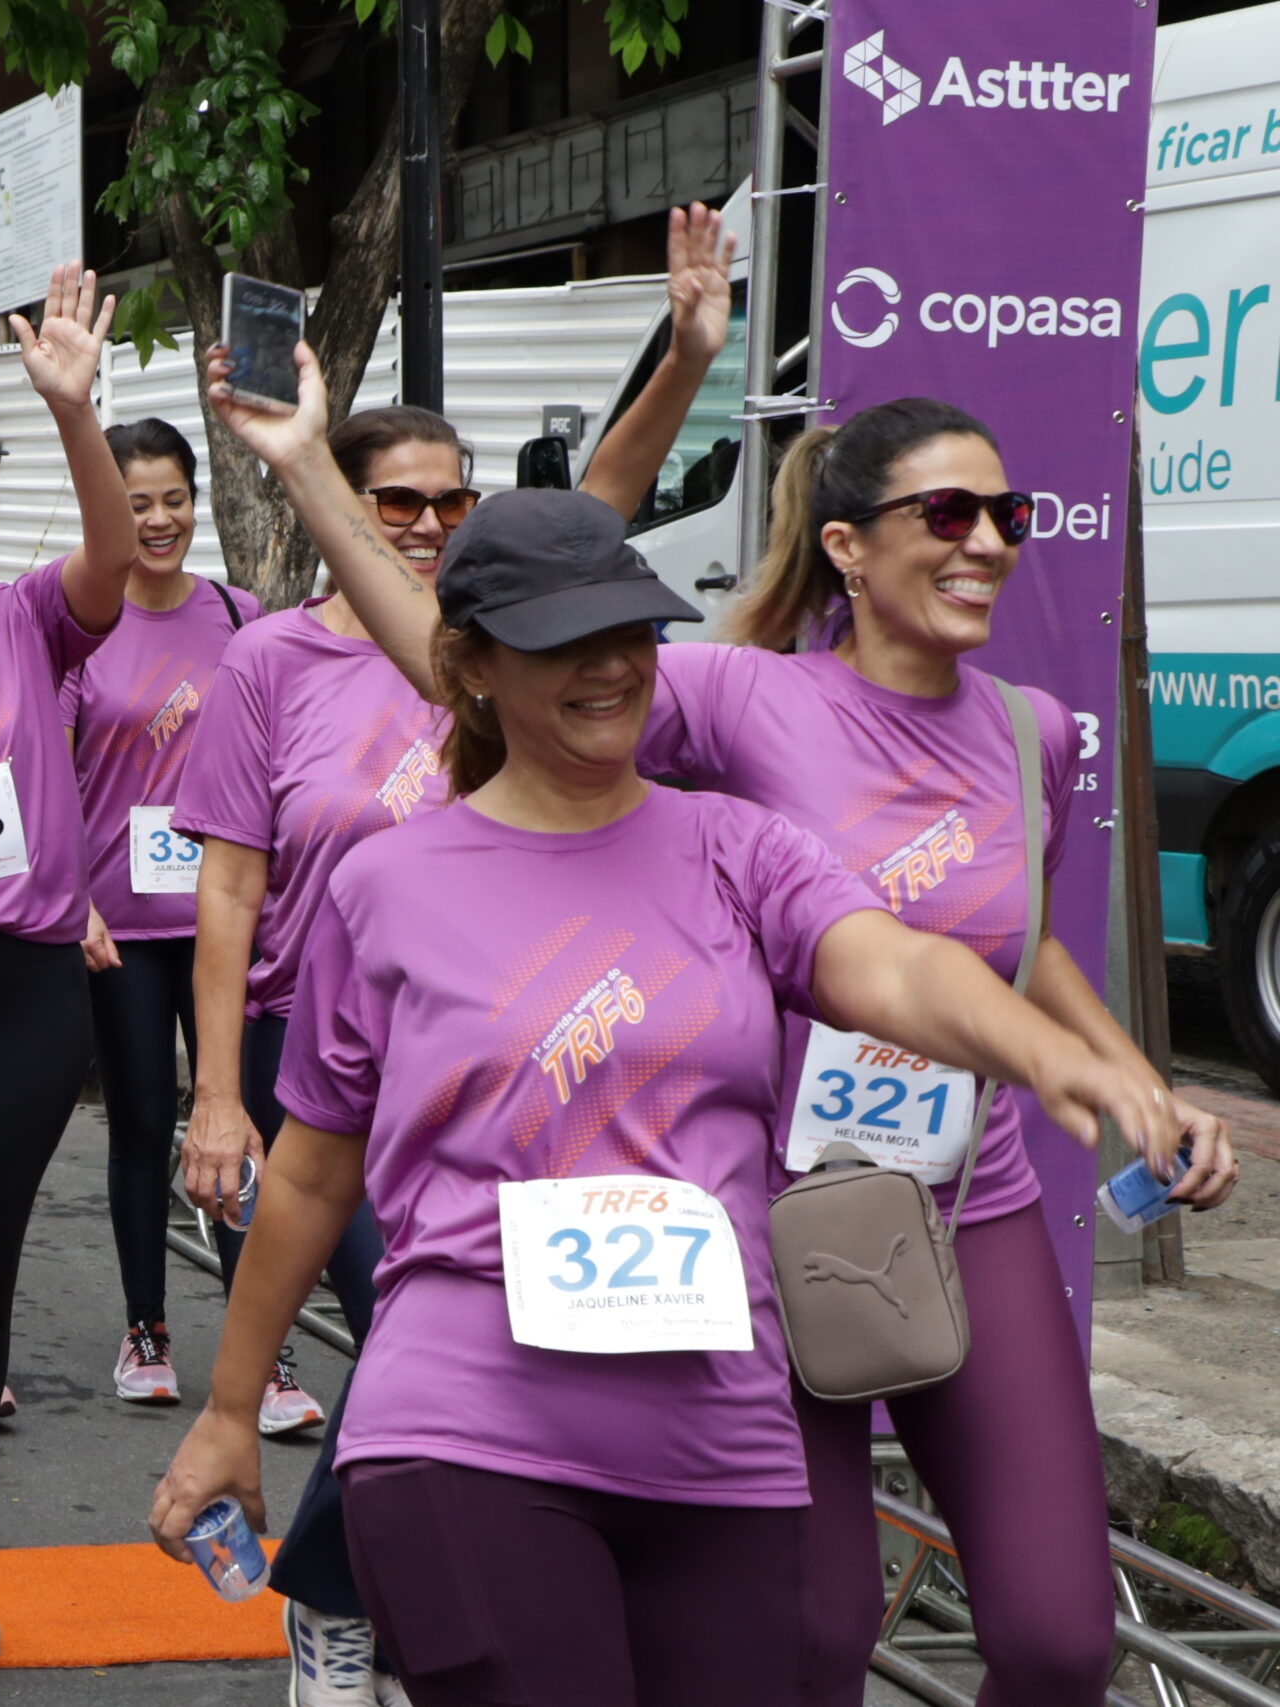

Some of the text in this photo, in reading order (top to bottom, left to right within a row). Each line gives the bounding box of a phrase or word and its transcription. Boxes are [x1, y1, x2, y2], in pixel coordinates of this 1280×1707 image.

[928, 56, 1131, 112] Asttter
[1156, 121, 1252, 171] ficar
[920, 292, 1122, 349] copasa
[550, 416, 571, 433] PGC
[1149, 438, 1232, 496] úde
[1030, 491, 1111, 541] Dei
[150, 683, 199, 751] TRF6
[382, 743, 441, 825] TRF6
[879, 817, 975, 914] TRF6
[542, 1012, 576, 1050] corrida
[572, 979, 610, 1015] solidária
[607, 967, 621, 981] do
[540, 975, 645, 1105] TRF6
[810, 1068, 949, 1136] 321
[834, 1127, 920, 1148] HELENA MOTA
[581, 1190, 669, 1215] TRF6
[546, 1224, 711, 1292] 327
[568, 1293, 705, 1310] JAQUELINE XAVIER
